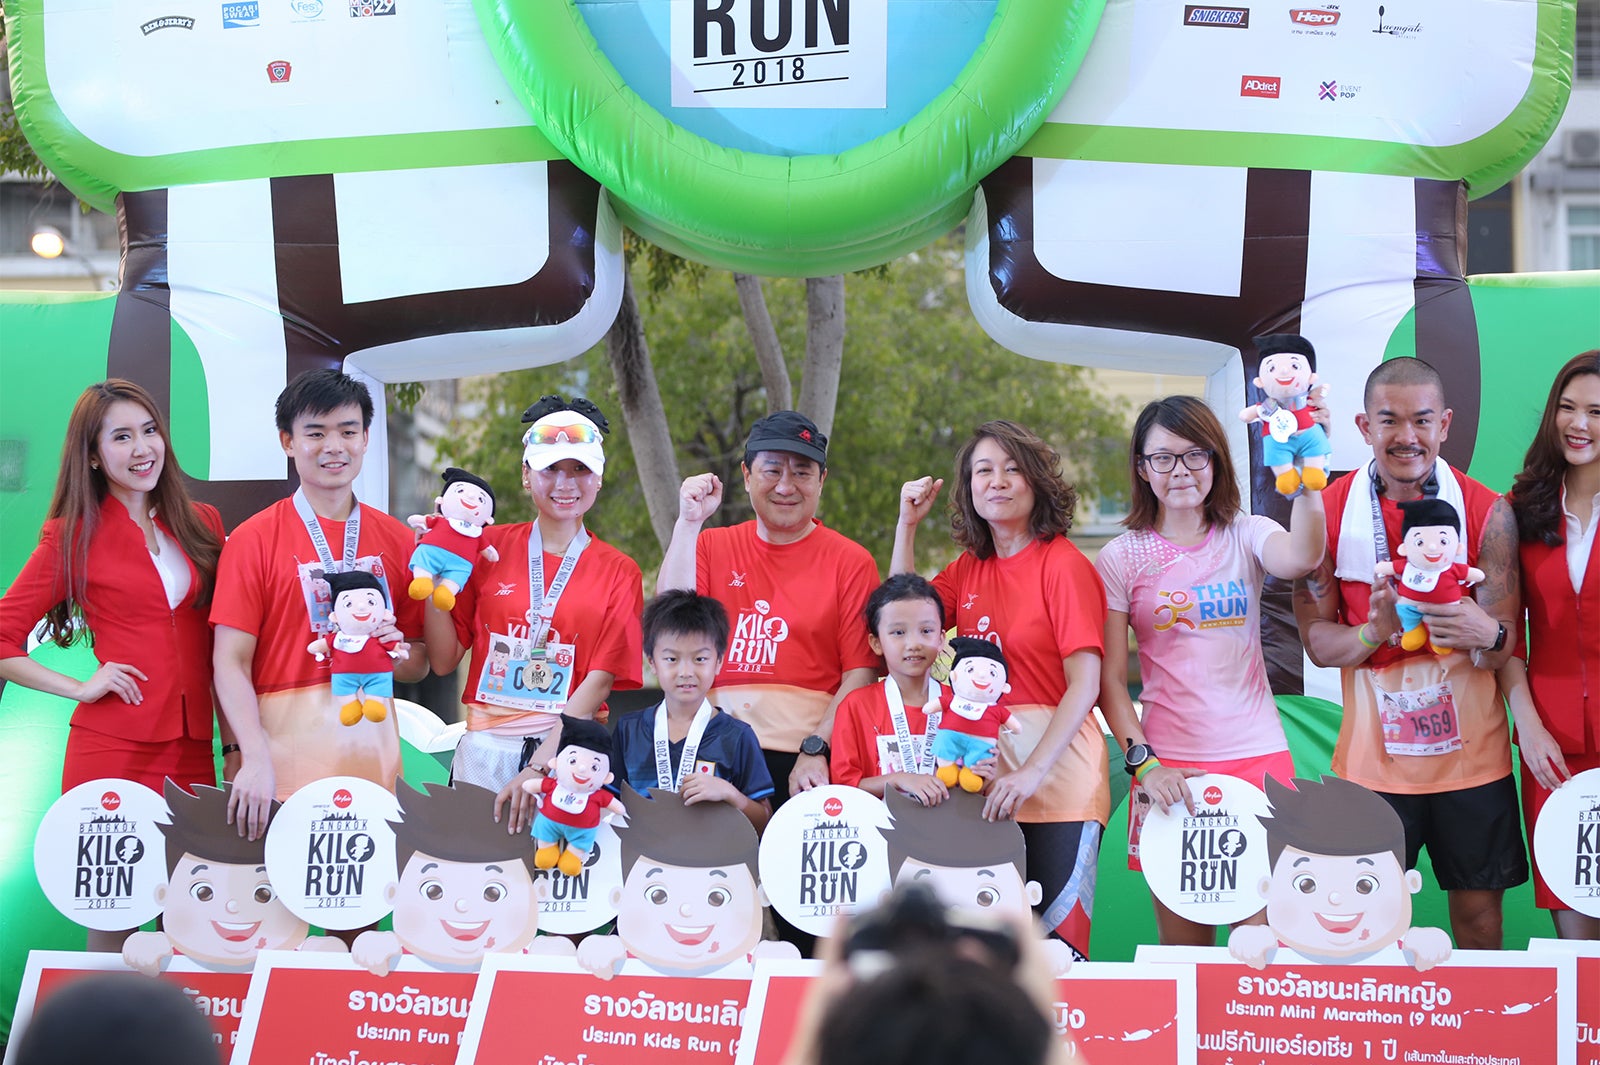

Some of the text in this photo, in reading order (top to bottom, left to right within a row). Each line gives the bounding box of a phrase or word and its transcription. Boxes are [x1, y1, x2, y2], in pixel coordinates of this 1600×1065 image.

[223, 4, 257, 13] POCARI
[224, 11, 255, 19] SWEAT
[1190, 9, 1242, 23] SNICKERS
[1296, 11, 1335, 23] Hero
[694, 0, 849, 58] RUN
[732, 57, 805, 86] 2018
[347, 519, 358, 535] 2018
[531, 556, 543, 582] FESTIVAL
[561, 555, 576, 571] 2018
[1191, 578, 1247, 601] THAI
[1199, 598, 1248, 620] RUN
[734, 613, 788, 643] KILO
[728, 638, 778, 664] RUN
[737, 663, 762, 673] 2018
[894, 711, 909, 743] FESTIVAL
[1410, 709, 1452, 738] 1669
[656, 740, 667, 759] 2018
[658, 760, 670, 775] RUN
[79, 822, 137, 834] BANGKOK
[311, 820, 367, 831] BANGKOK
[803, 826, 858, 840] BANGKOK
[1183, 816, 1239, 828] BANGKOK
[77, 835, 145, 866] KILO
[308, 833, 375, 864] KILO
[1181, 829, 1247, 860] KILO
[801, 840, 868, 873] KILO
[75, 866, 134, 897] RUN
[305, 864, 364, 896] RUN
[1180, 860, 1237, 891] RUN
[800, 871, 857, 904] RUN
[1194, 892, 1220, 902] 2018
[88, 900, 116, 909] 2018
[318, 897, 345, 907] 2018
[544, 901, 571, 911] 2018
[814, 905, 841, 916] 2018
[1237, 971, 1452, 1011] รางวัลชนะเลิศหญิง
[1226, 1000, 1462, 1030] ประเภท Mini Marathon (9 KM)
[357, 1022, 411, 1042] ประเภท
[418, 1029, 449, 1045] Fun
[582, 1026, 637, 1046] ประเภท
[643, 1031, 681, 1050] Kids
[688, 1036, 721, 1053] Run
[1364, 1040, 1372, 1060] 1
[1381, 1038, 1397, 1060] ปี
